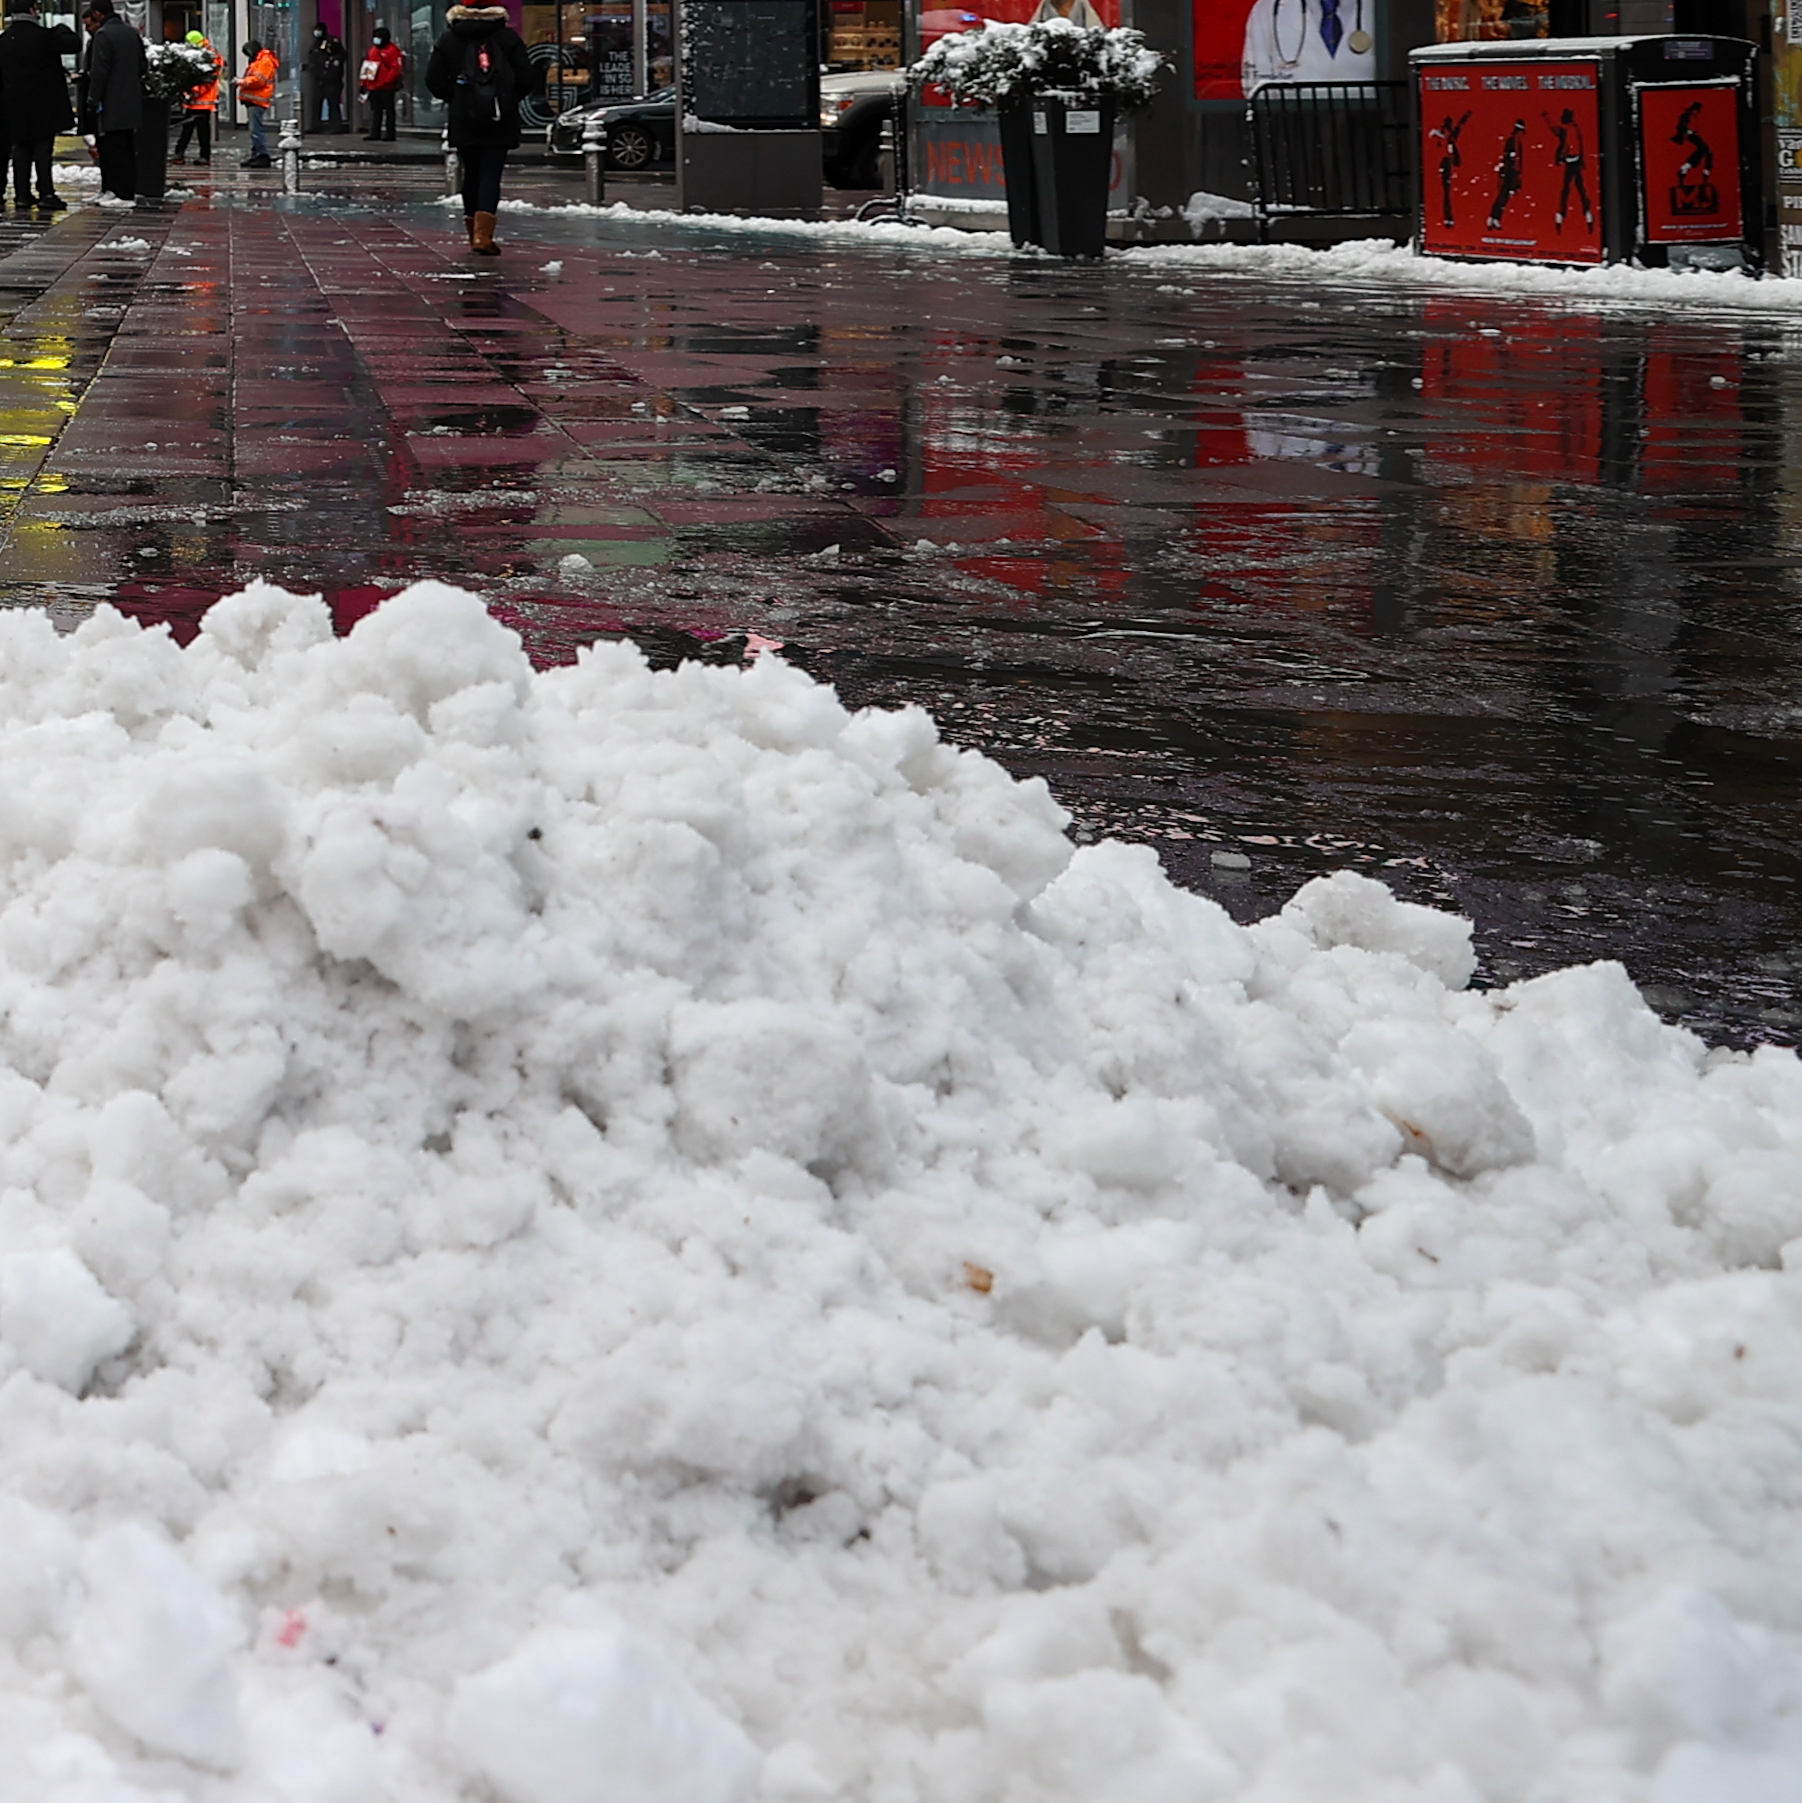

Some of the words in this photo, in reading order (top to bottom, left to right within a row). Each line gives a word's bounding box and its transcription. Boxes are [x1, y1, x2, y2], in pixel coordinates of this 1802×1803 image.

[608, 51, 628, 61] THE
[1426, 77, 1443, 90] THE
[1481, 76, 1498, 90] THE
[1538, 76, 1555, 90] THE
